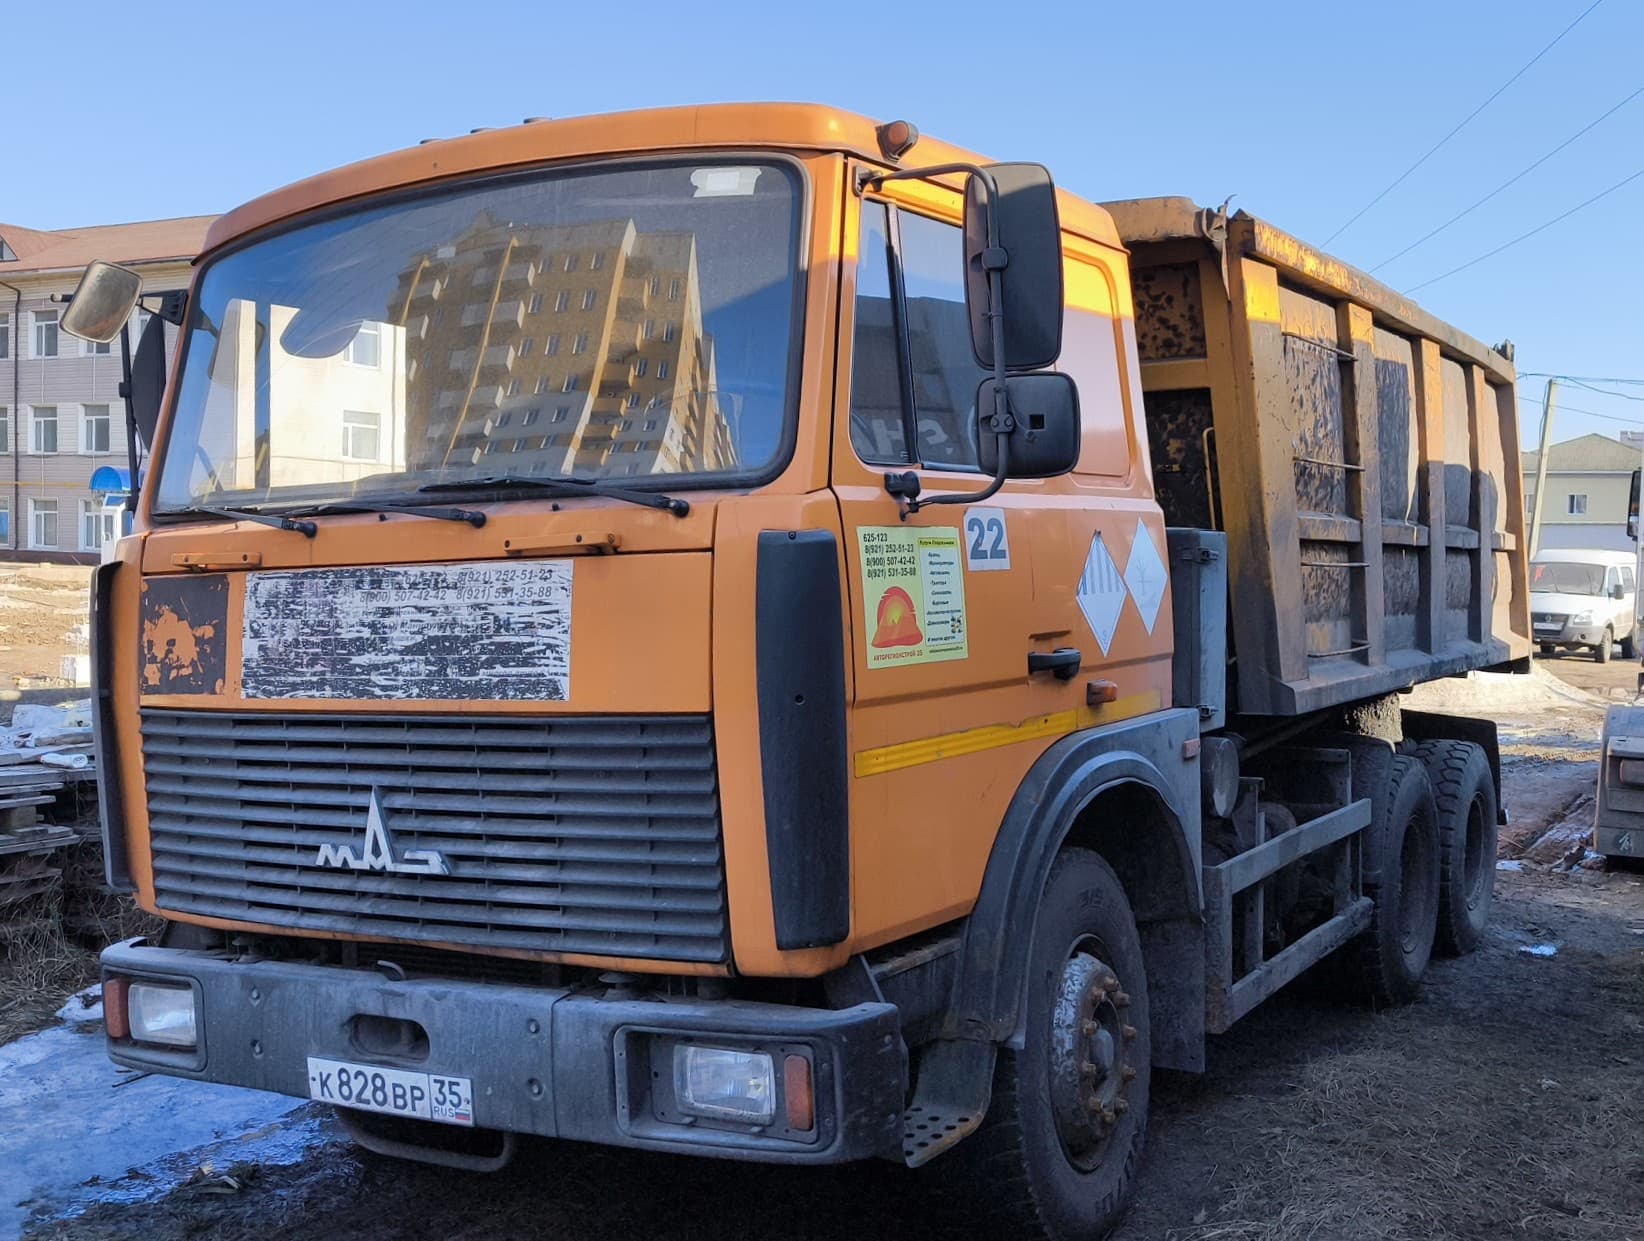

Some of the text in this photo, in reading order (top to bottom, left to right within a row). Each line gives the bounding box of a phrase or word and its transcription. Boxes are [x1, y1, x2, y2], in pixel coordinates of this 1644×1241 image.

[863, 533, 888, 543] 625-123
[967, 517, 1007, 560] 22
[864, 544, 884, 555] 8(921)
[887, 556, 915, 566] 507-42-42
[495, 568, 553, 582] 252-51-23
[394, 588, 447, 602] 507-42-42
[456, 587, 491, 602] 8(921)
[433, 1079, 462, 1108] 35
[433, 1105, 455, 1118] RUS
